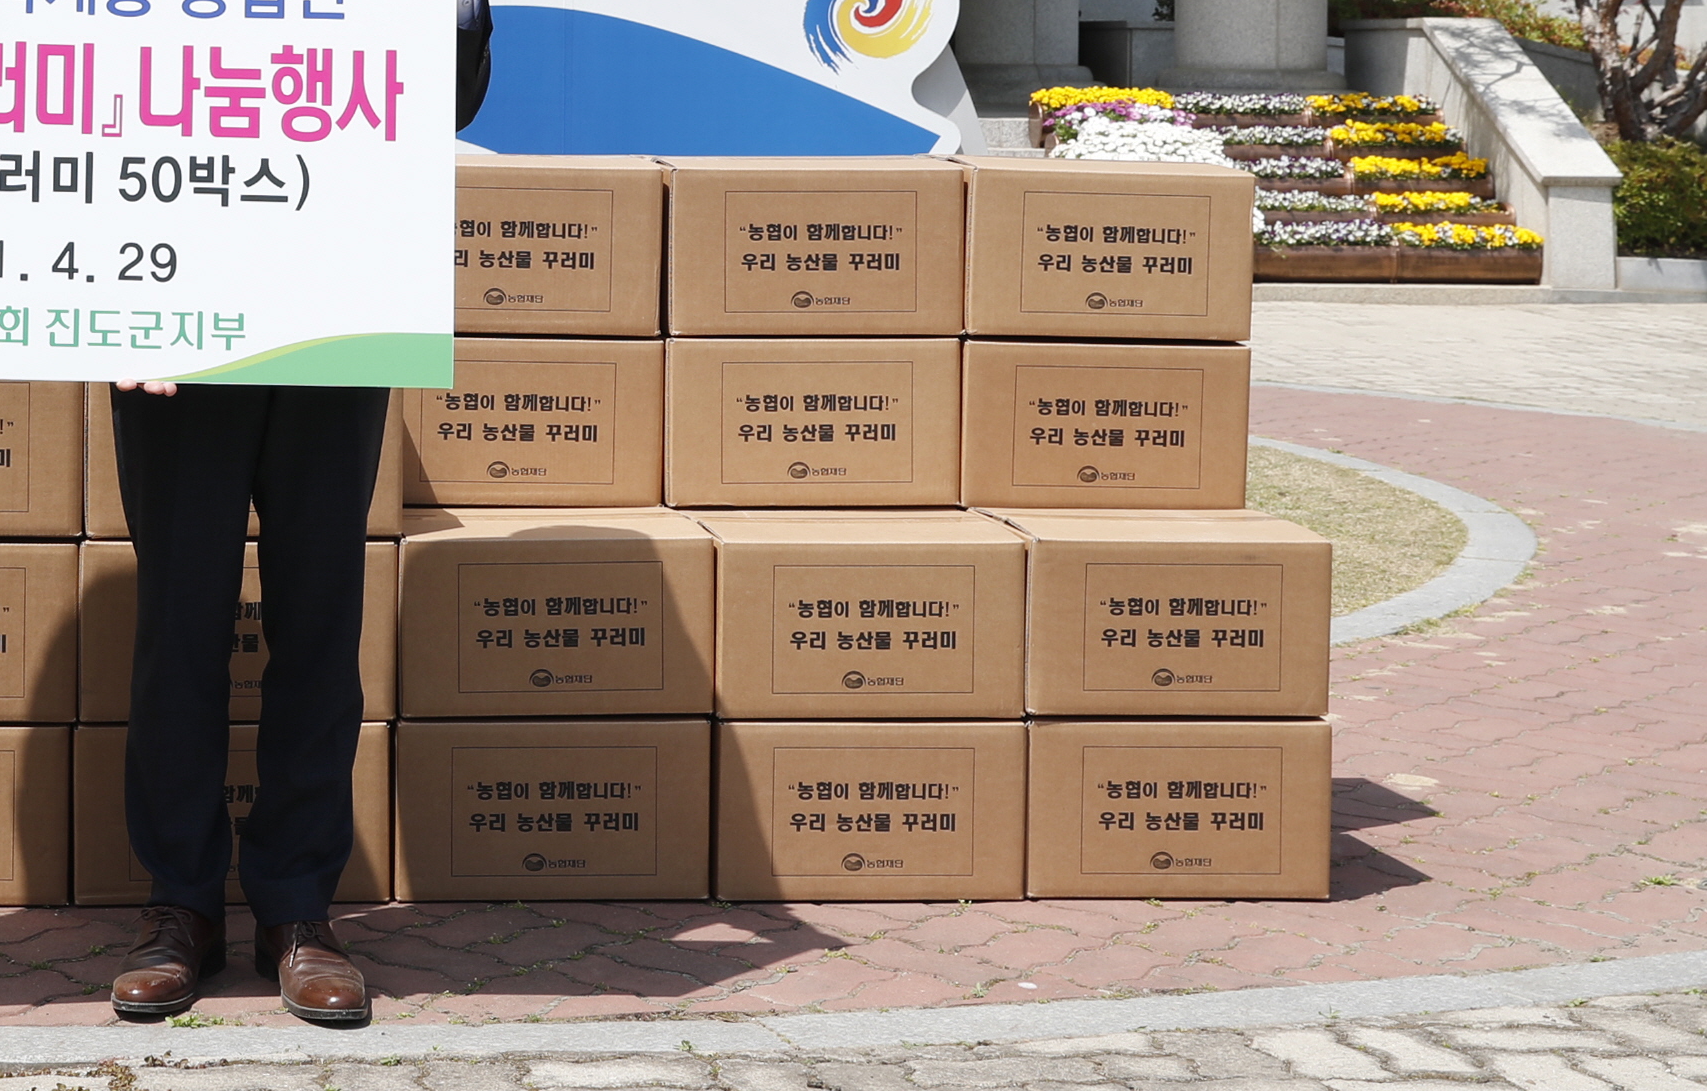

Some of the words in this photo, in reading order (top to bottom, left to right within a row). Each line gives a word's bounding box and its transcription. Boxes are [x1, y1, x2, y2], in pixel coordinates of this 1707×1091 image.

[139, 45, 404, 140] 나눔행사
[119, 154, 310, 211] 50박스)
[52, 242, 94, 283] 4.
[118, 242, 177, 283] 29
[479, 250, 531, 269] 농산물
[542, 251, 594, 269] 꾸러미
[741, 253, 775, 271] 우리
[786, 253, 838, 271] 농산물
[848, 253, 900, 271] 꾸러미
[1038, 254, 1071, 272] 우리
[1081, 255, 1132, 273] 농산물
[1142, 257, 1193, 274] 꾸러미
[46, 309, 245, 350] 진도군지부
[437, 422, 472, 441] 우리
[482, 423, 535, 441] 농산물
[546, 425, 598, 442] 꾸러미
[738, 424, 772, 442] 우리
[782, 424, 834, 442] 농산물
[845, 424, 896, 441] 꾸러미
[1030, 427, 1063, 445] 우리
[1073, 428, 1124, 446] 농산물
[1134, 430, 1185, 447] 꾸러미
[476, 629, 512, 648] 우리
[524, 629, 579, 648] 농산물
[590, 627, 646, 647] 꾸러미
[790, 631, 826, 650] 우리
[837, 631, 891, 650] 농산물
[903, 631, 957, 650] 꾸러미
[1101, 629, 1136, 647] 우리
[1147, 629, 1200, 648] 농산물
[1211, 629, 1264, 648] 꾸러미
[469, 813, 506, 832] 우리
[517, 813, 572, 832] 농산물
[584, 812, 639, 832] 꾸러미
[790, 813, 825, 832] 우리
[836, 813, 891, 832] 농산물
[902, 813, 956, 832] 꾸러미
[1099, 812, 1134, 831] 우리
[1145, 812, 1199, 831] 농산물
[1210, 812, 1264, 831] 꾸러미
